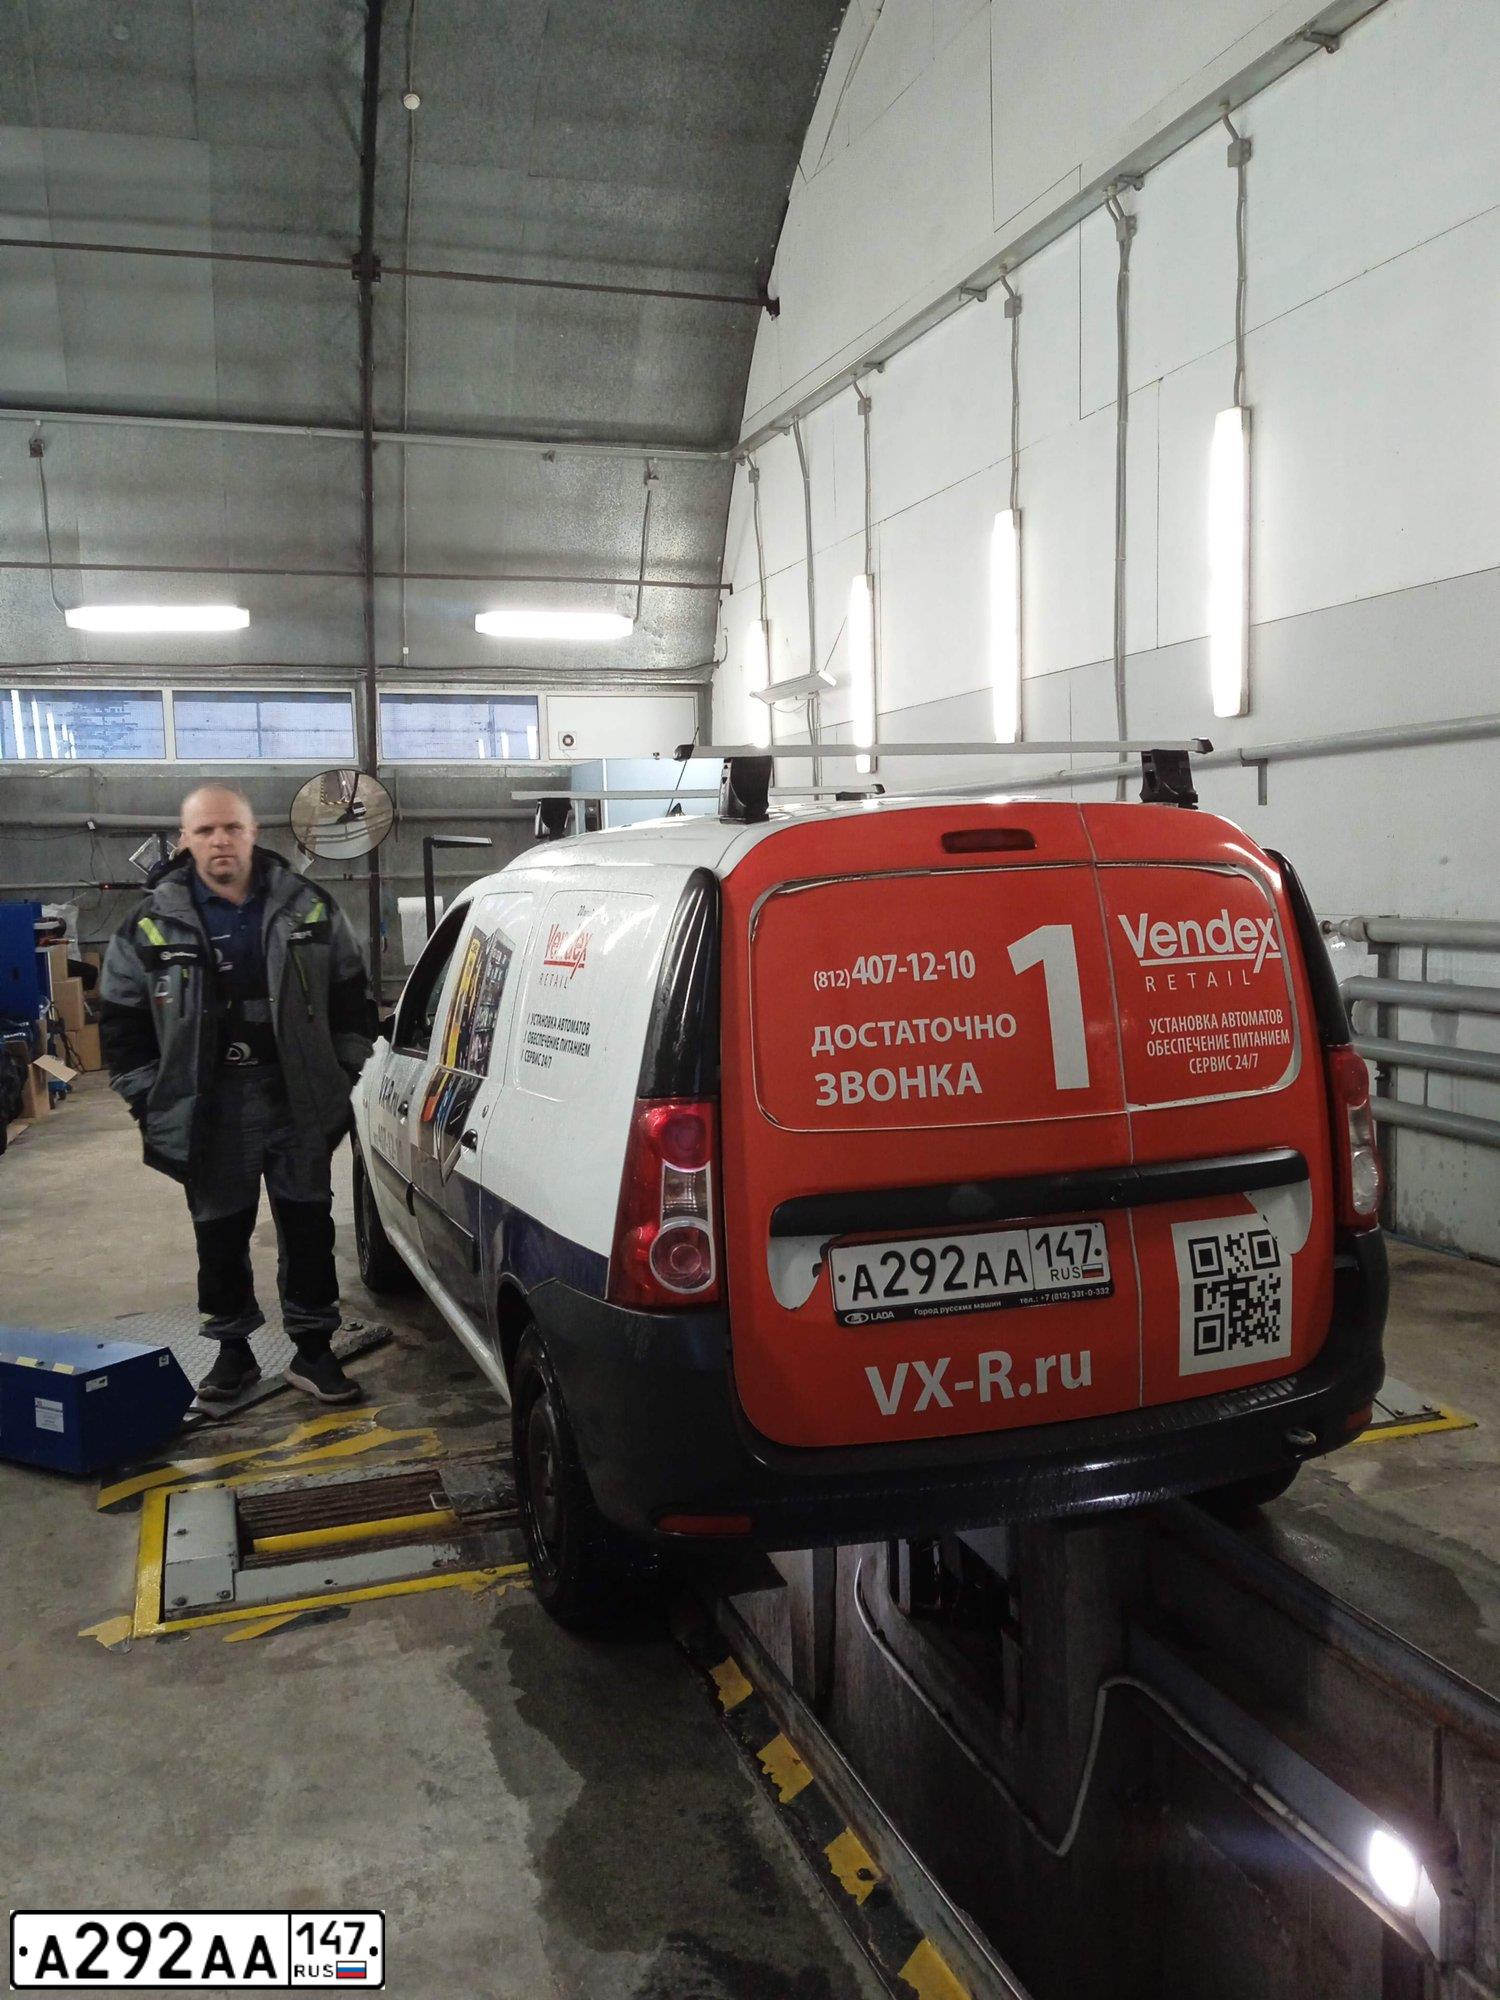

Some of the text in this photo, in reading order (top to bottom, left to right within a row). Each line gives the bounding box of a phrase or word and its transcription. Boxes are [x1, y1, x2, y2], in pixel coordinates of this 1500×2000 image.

[544, 923, 593, 979] Veex
[1117, 909, 1281, 974] Vendex
[1145, 969, 1251, 992] RETAIL
[1006, 924, 1090, 1090] 1
[1149, 1008, 1283, 1035] УСТАНОВКА АВТОМАТОВ
[811, 1013, 1017, 1058] ДОСТАТОЧНО
[1146, 1029, 1290, 1057] ОБЕСПЕЧЕНИЕ ПИТАНИЕМ
[1189, 1053, 1259, 1075] СЕРВИС 24/7
[815, 1062, 983, 1107] ЗВОНКА
[1035, 1229, 1093, 1268] 147
[1050, 1267, 1081, 1282] RUS
[870, 1311, 895, 1321] LADA
[913, 1299, 1002, 1316] Город русских машин
[864, 1349, 1094, 1417] VX-R.ru
